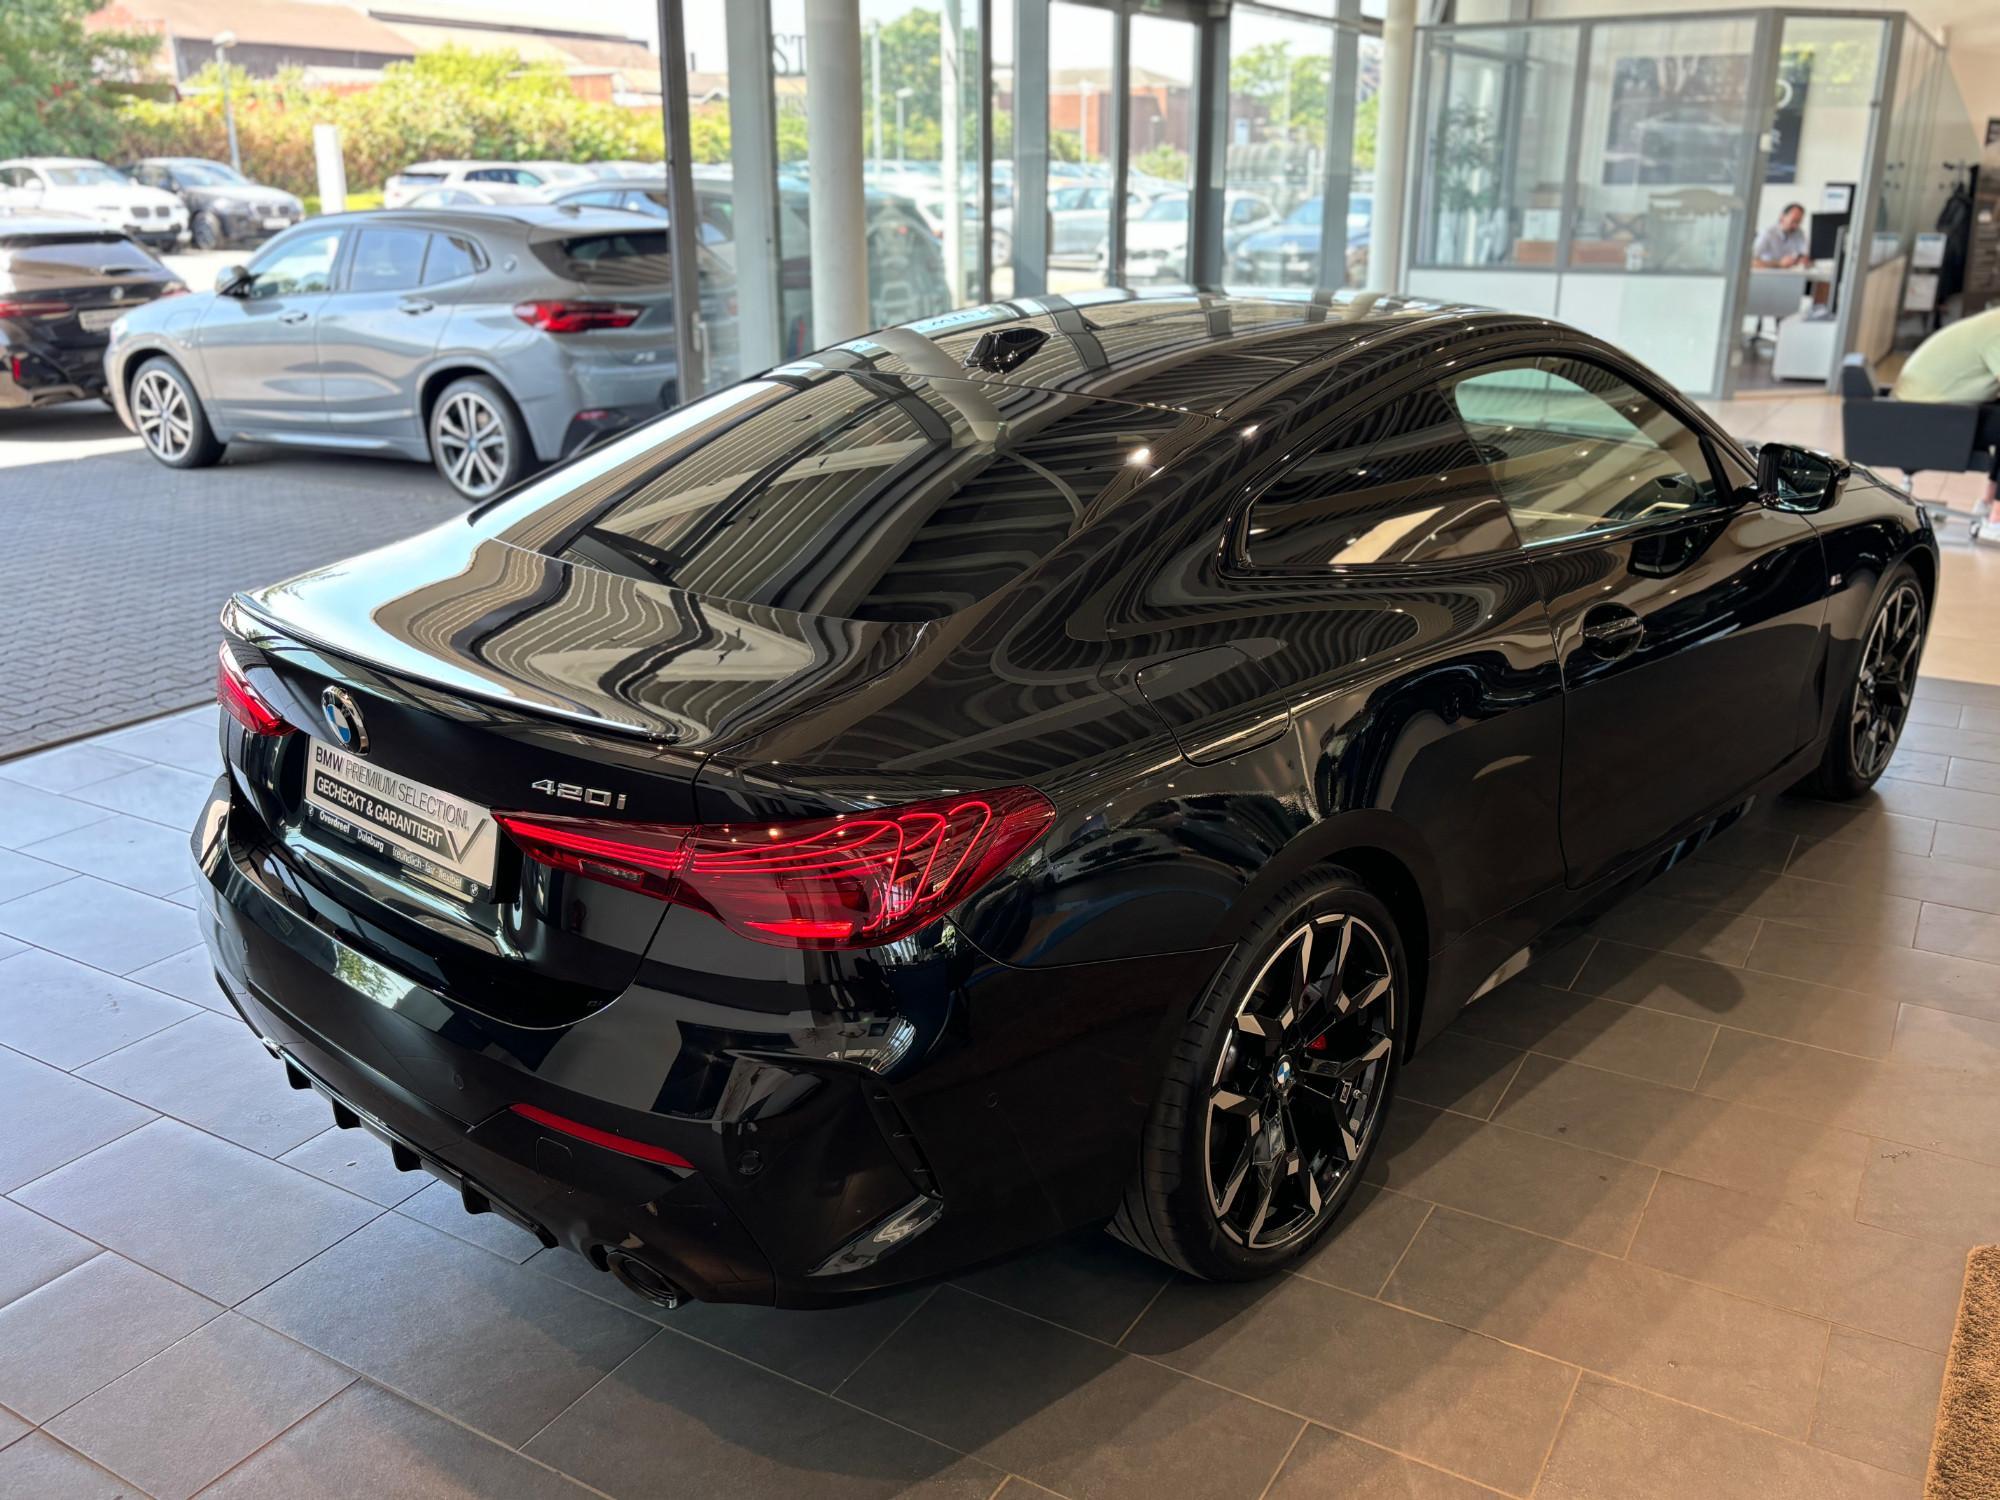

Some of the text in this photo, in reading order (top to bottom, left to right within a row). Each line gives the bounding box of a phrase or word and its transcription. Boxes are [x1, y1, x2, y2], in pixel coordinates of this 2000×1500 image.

[315, 746, 343, 772] BMW
[346, 759, 396, 798] PREMIUM
[531, 779, 627, 810] 420i
[316, 777, 443, 848] GECHECKT & GARANTIERT
